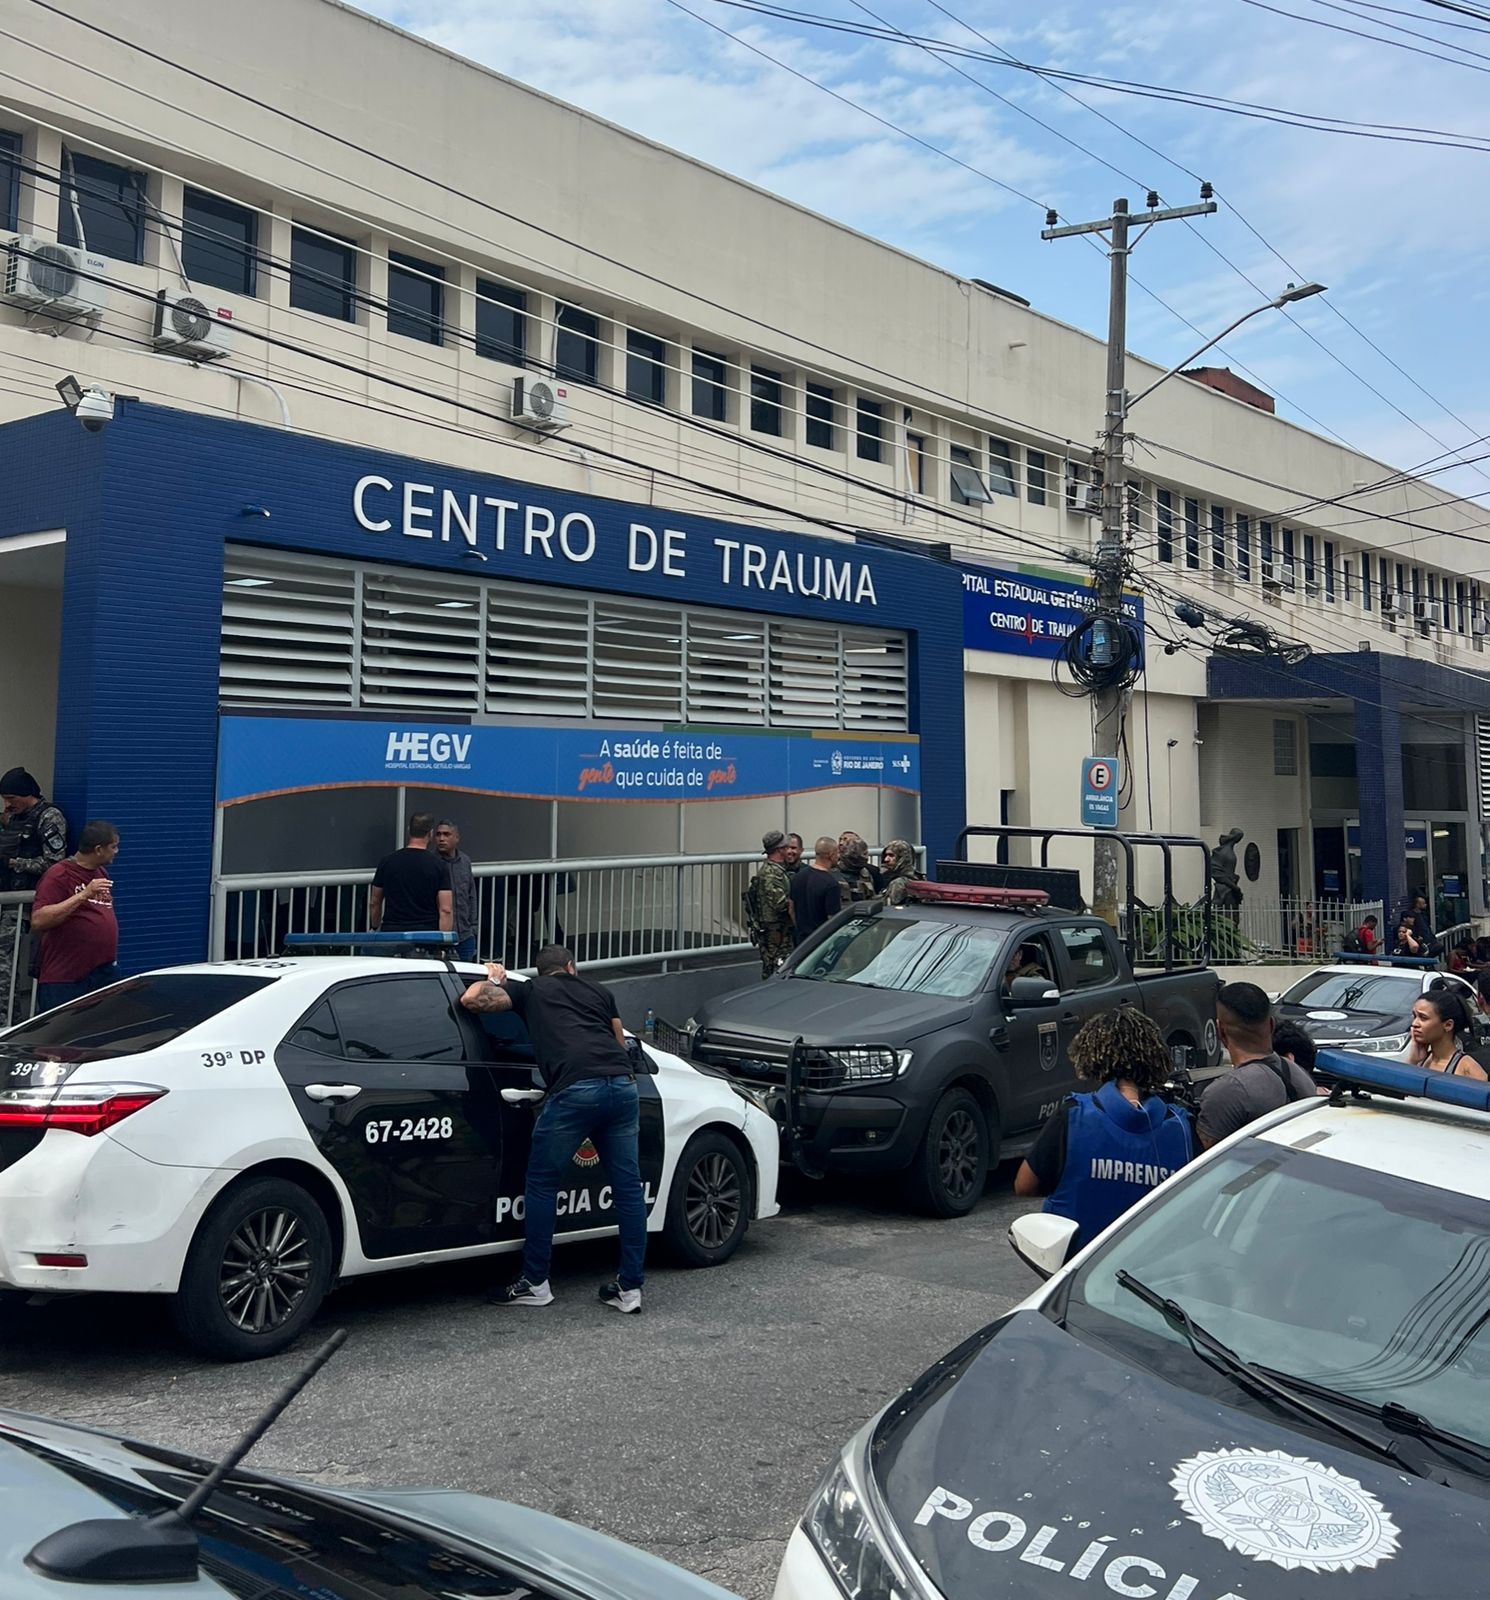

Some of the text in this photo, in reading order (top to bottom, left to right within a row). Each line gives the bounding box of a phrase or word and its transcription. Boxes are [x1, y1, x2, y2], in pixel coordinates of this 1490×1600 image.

[352, 475, 878, 606] CENTRO DE TRAUMA
[994, 579, 1050, 606] ESTADUAL
[990, 612, 1077, 638] CENTRO DE TRAUM
[385, 732, 472, 762] HEGV
[600, 739, 722, 760] A saúde é feita de
[843, 761, 884, 769] RIO DE JANEIRO
[1096, 768, 1104, 784] E
[616, 771, 643, 789] que
[646, 768, 684, 786] cuida
[687, 768, 704, 786] de
[10, 1062, 39, 1076] 39ª
[201, 1050, 266, 1068] 39ª DP
[365, 1116, 453, 1144] 67-2428
[496, 1188, 591, 1223] POCIA
[913, 1486, 1248, 1600] POLÍCI
